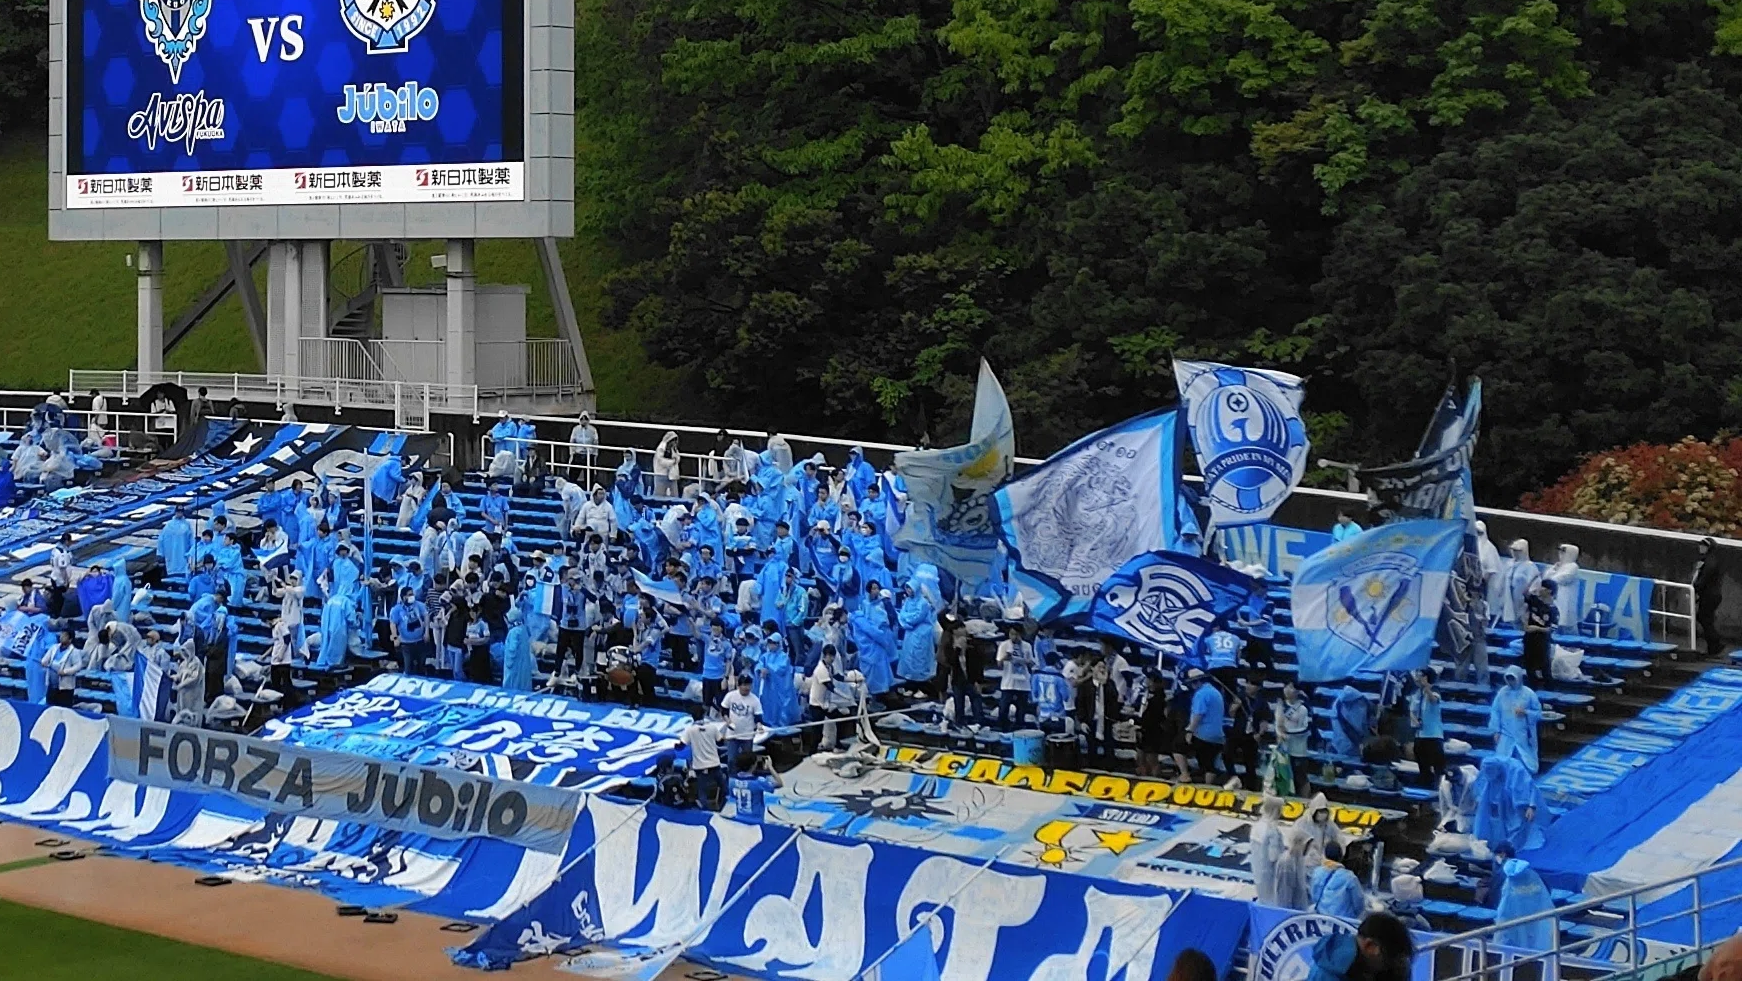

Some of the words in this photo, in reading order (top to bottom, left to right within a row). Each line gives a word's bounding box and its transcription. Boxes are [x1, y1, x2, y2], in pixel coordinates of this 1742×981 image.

[350, 12, 378, 40] SINCE
[395, 5, 427, 39] 1992
[247, 14, 304, 63] VS
[196, 128, 225, 139] FUKUOKA
[369, 120, 406, 134] IWATA
[90, 177, 153, 194] 新日本製薬
[195, 174, 263, 192] 新日本製薬
[308, 170, 382, 189] 新日本製薬
[431, 167, 511, 186] 新日本製薬
[137, 726, 315, 809] FORZA
